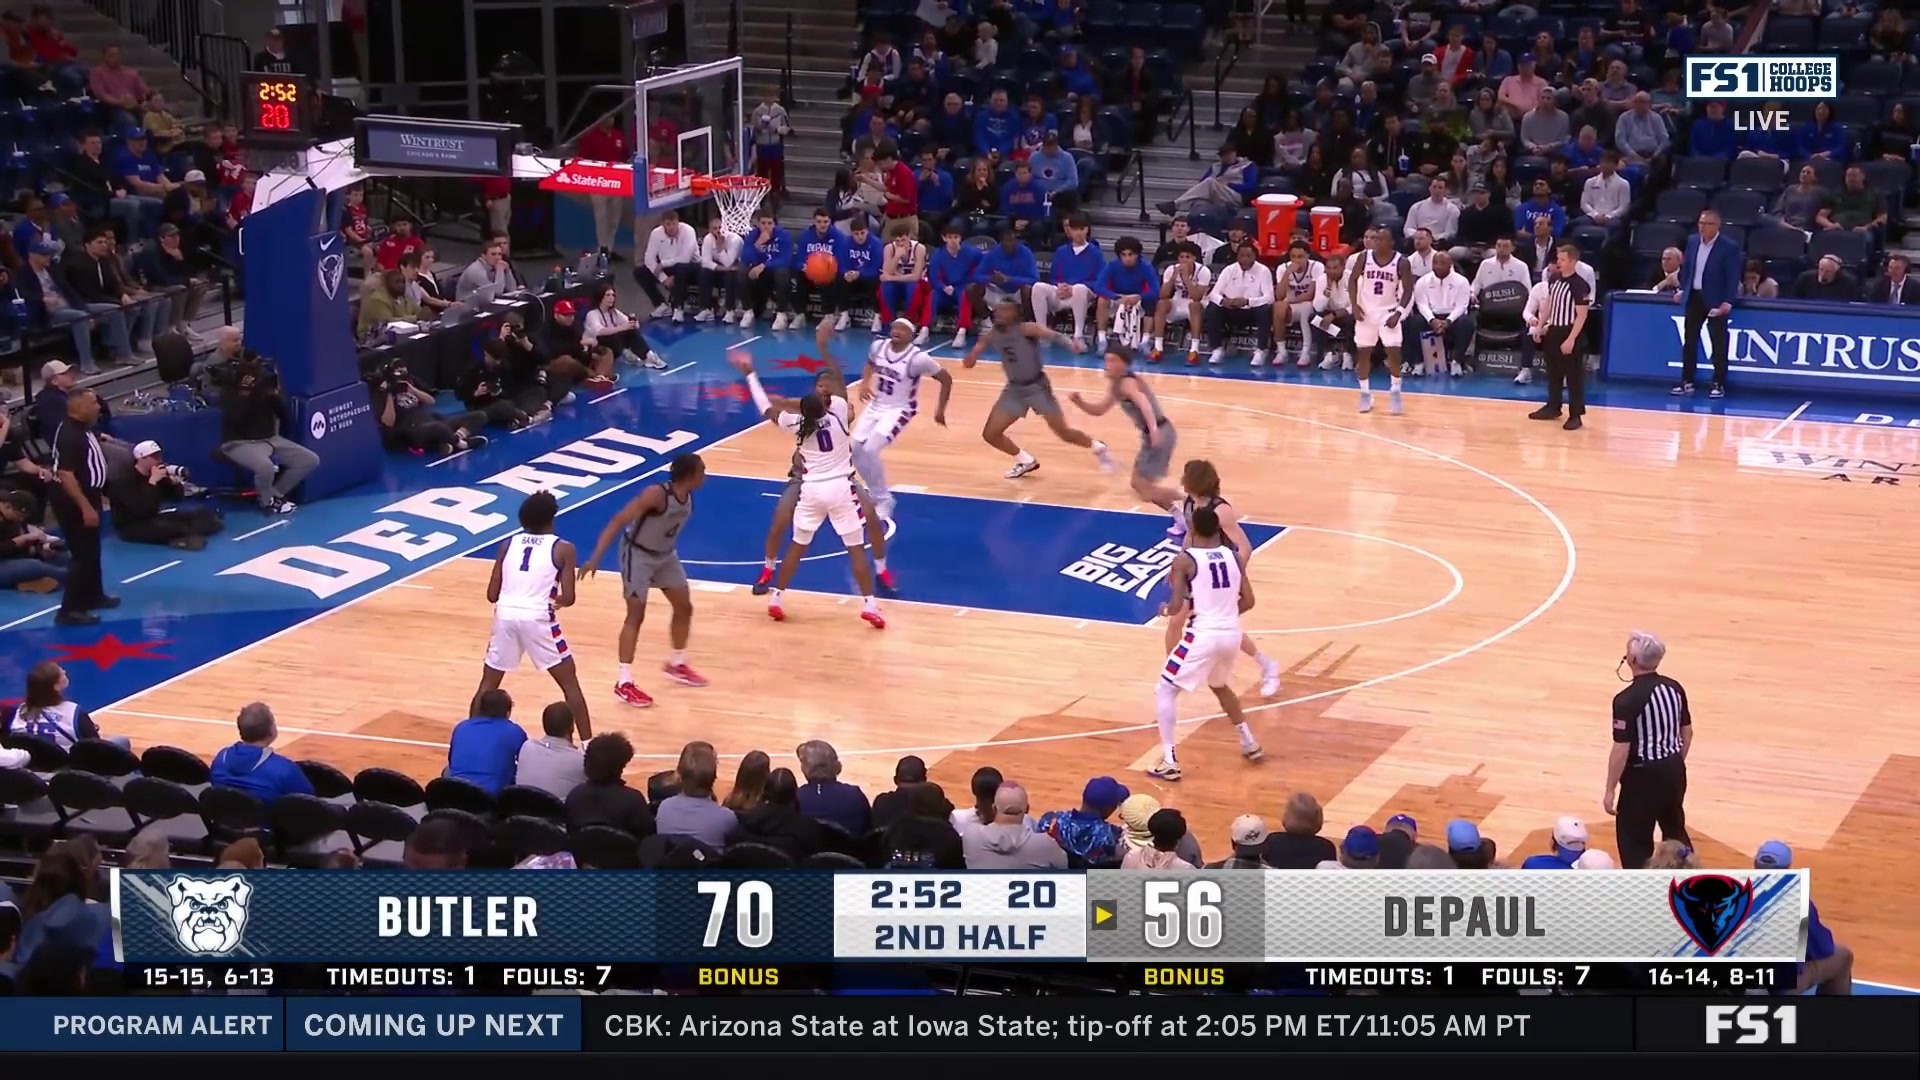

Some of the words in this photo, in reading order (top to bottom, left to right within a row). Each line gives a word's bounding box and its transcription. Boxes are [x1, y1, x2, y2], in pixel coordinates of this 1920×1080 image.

[259, 82, 297, 102] 2:52
[262, 103, 290, 128] 20
[400, 133, 464, 150] WINTRUST
[1373, 281, 1383, 295] 2
[816, 429, 834, 453] 0
[214, 426, 700, 601] DEPAUL
[519, 546, 533, 572] 1
[1059, 542, 1140, 583] BIG
[1096, 537, 1184, 593] EAST
[1208, 561, 1231, 589] 11
